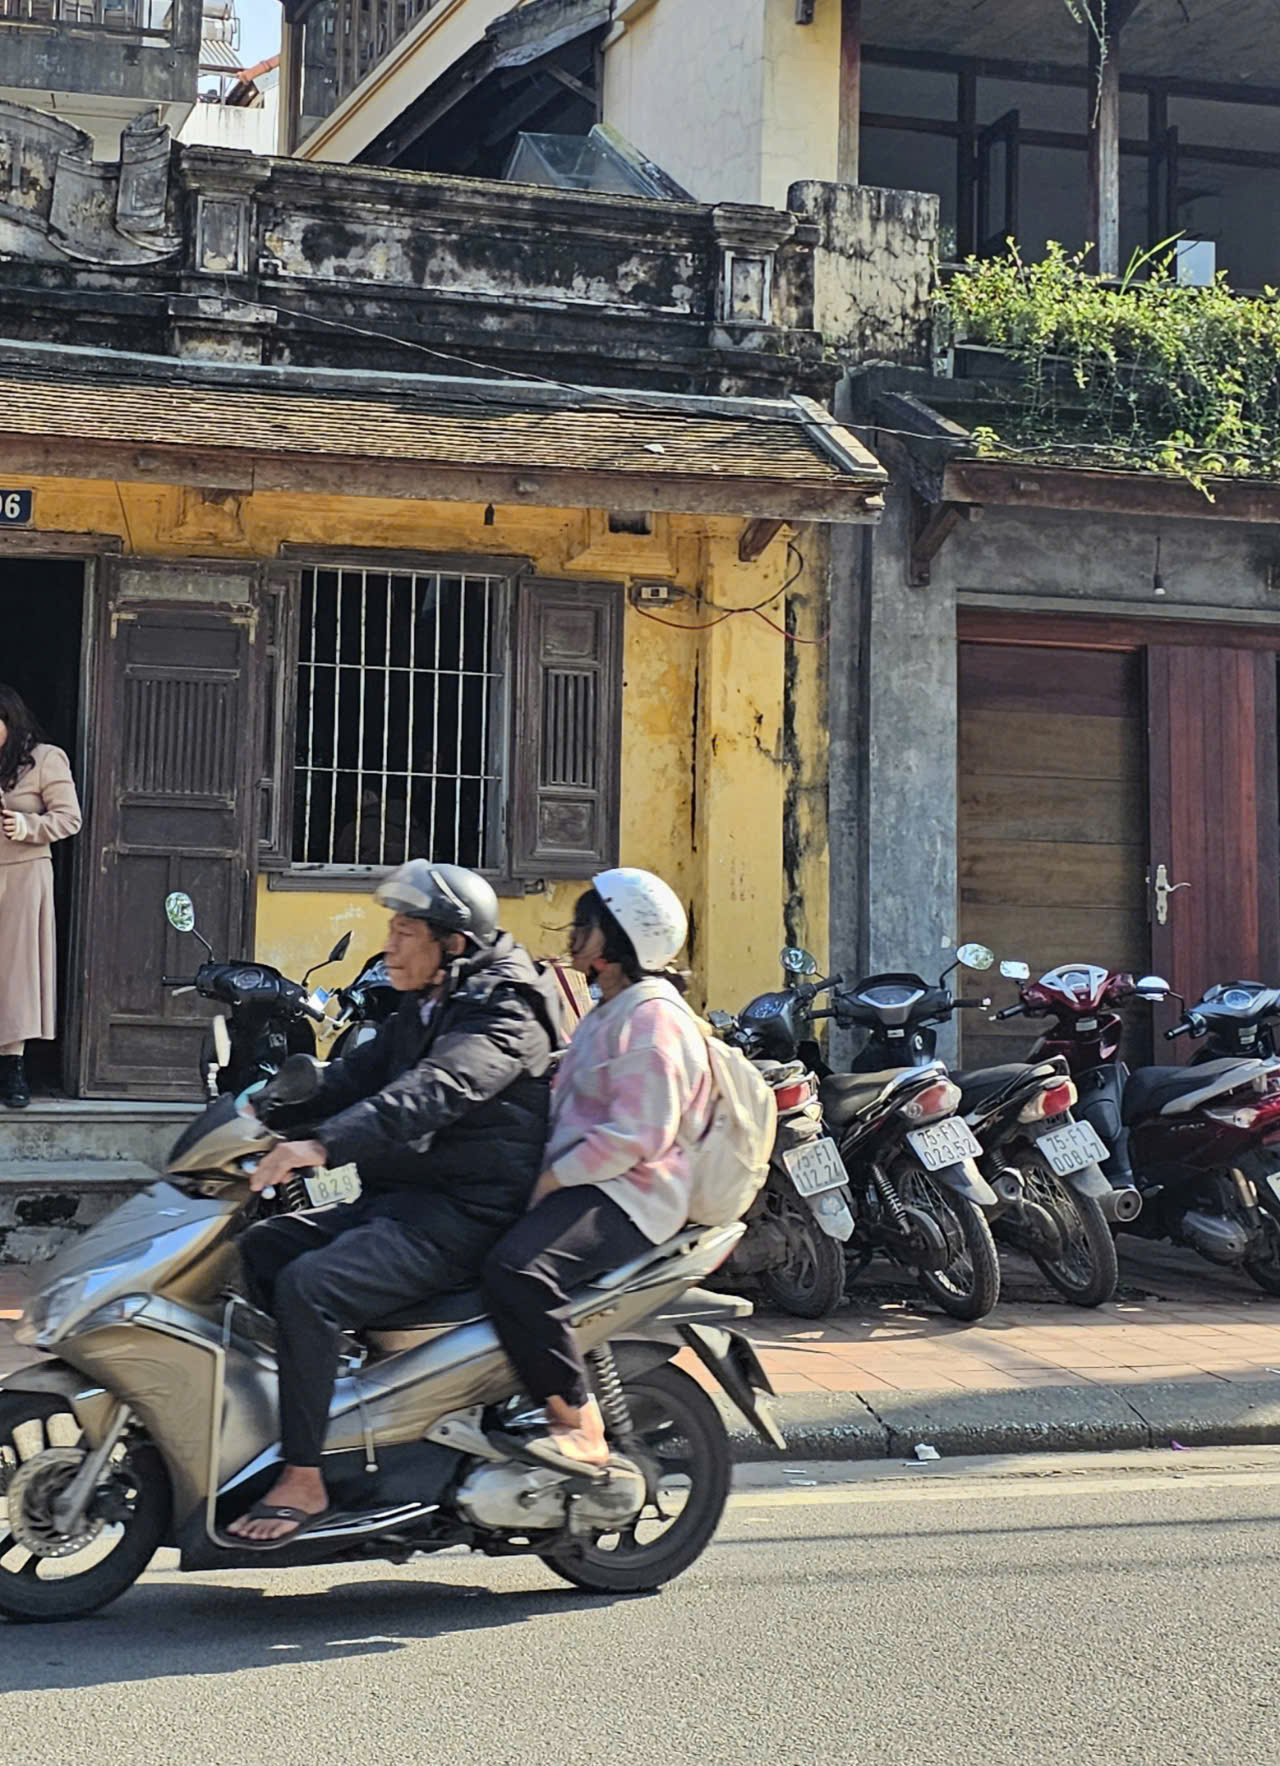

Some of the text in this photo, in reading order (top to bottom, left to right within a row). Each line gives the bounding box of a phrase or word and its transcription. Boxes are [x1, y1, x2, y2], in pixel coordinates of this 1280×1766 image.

[917, 1123, 960, 1148] 75-F1
[1046, 1127, 1088, 1153] 75-F1
[924, 1138, 977, 1167] 023.52
[1053, 1142, 1102, 1172] 008.47
